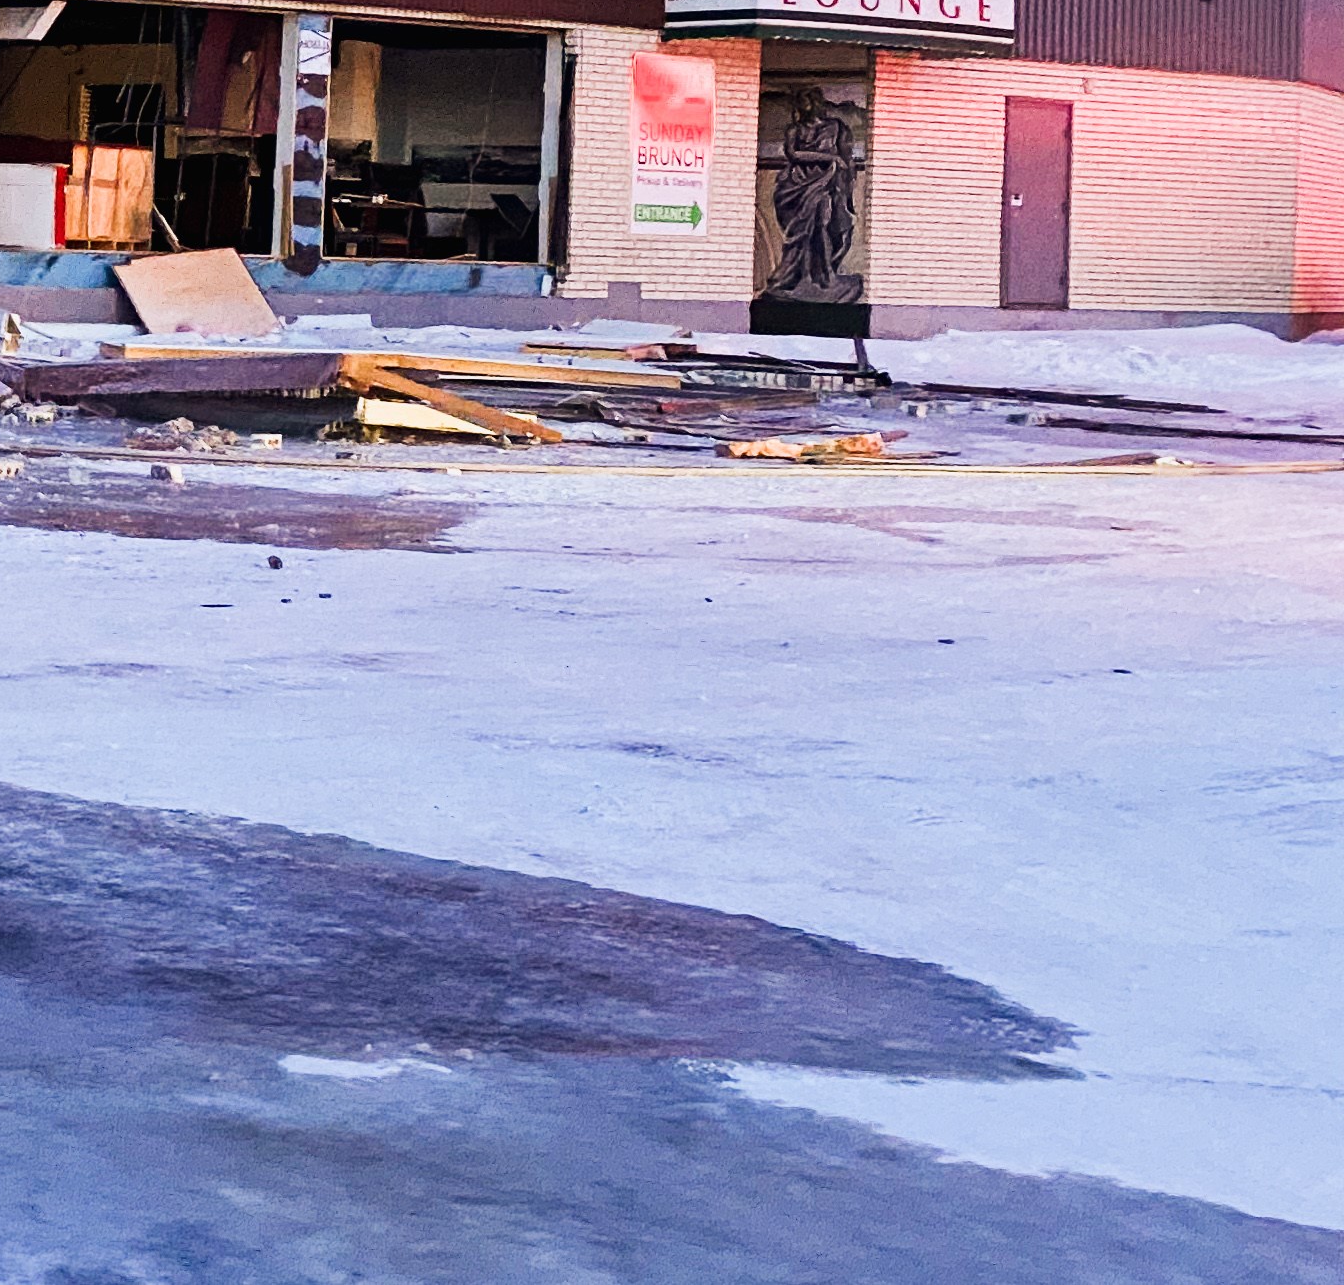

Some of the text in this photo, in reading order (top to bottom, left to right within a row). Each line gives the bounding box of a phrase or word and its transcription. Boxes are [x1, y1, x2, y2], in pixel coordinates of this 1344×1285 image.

[639, 122, 705, 143] SUNDAY
[638, 146, 705, 167] BRUNCH
[636, 205, 693, 223] ENTRANCE
